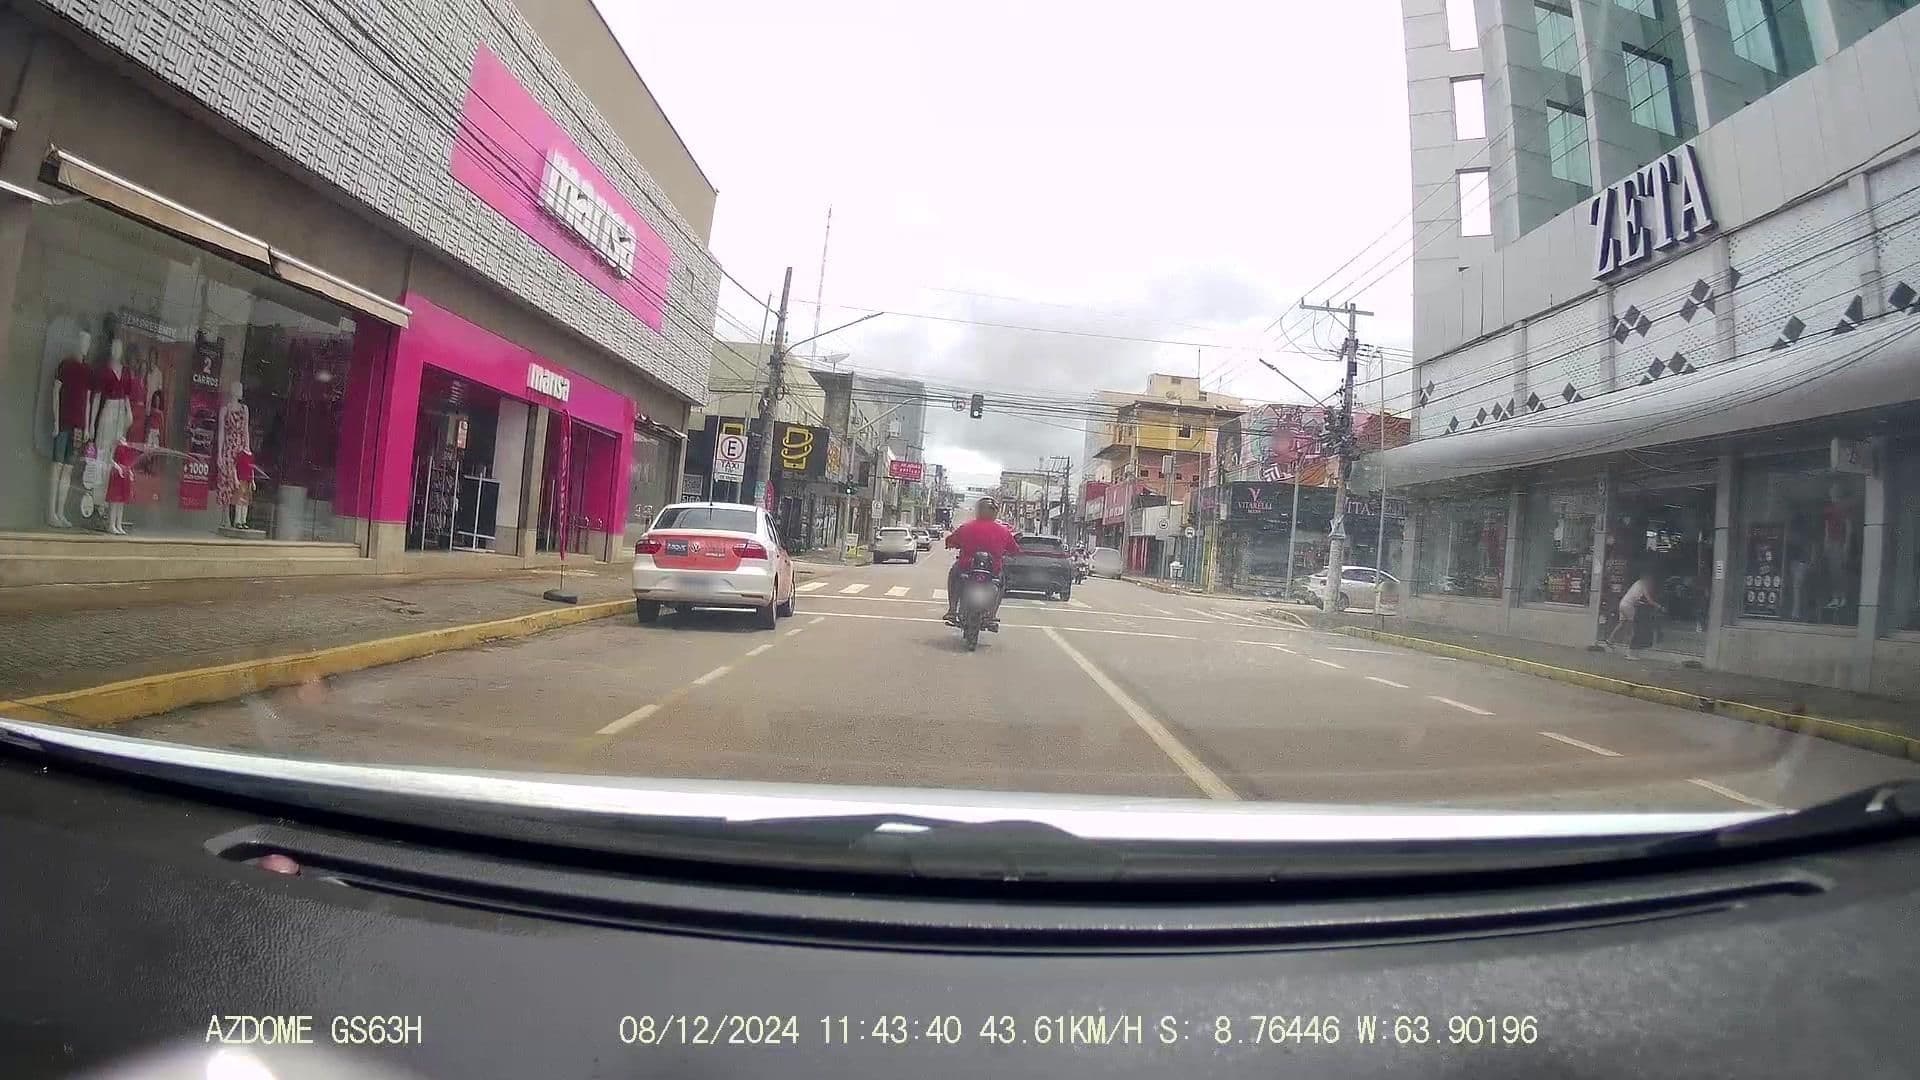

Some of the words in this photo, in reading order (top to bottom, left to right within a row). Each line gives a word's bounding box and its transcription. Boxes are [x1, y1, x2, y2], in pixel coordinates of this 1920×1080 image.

[539, 146, 637, 281] marisa
[1589, 144, 1715, 281] ZETA
[203, 357, 212, 374] 2
[527, 362, 570, 402] marisa
[727, 440, 737, 456] E
[720, 461, 740, 470] TAXI
